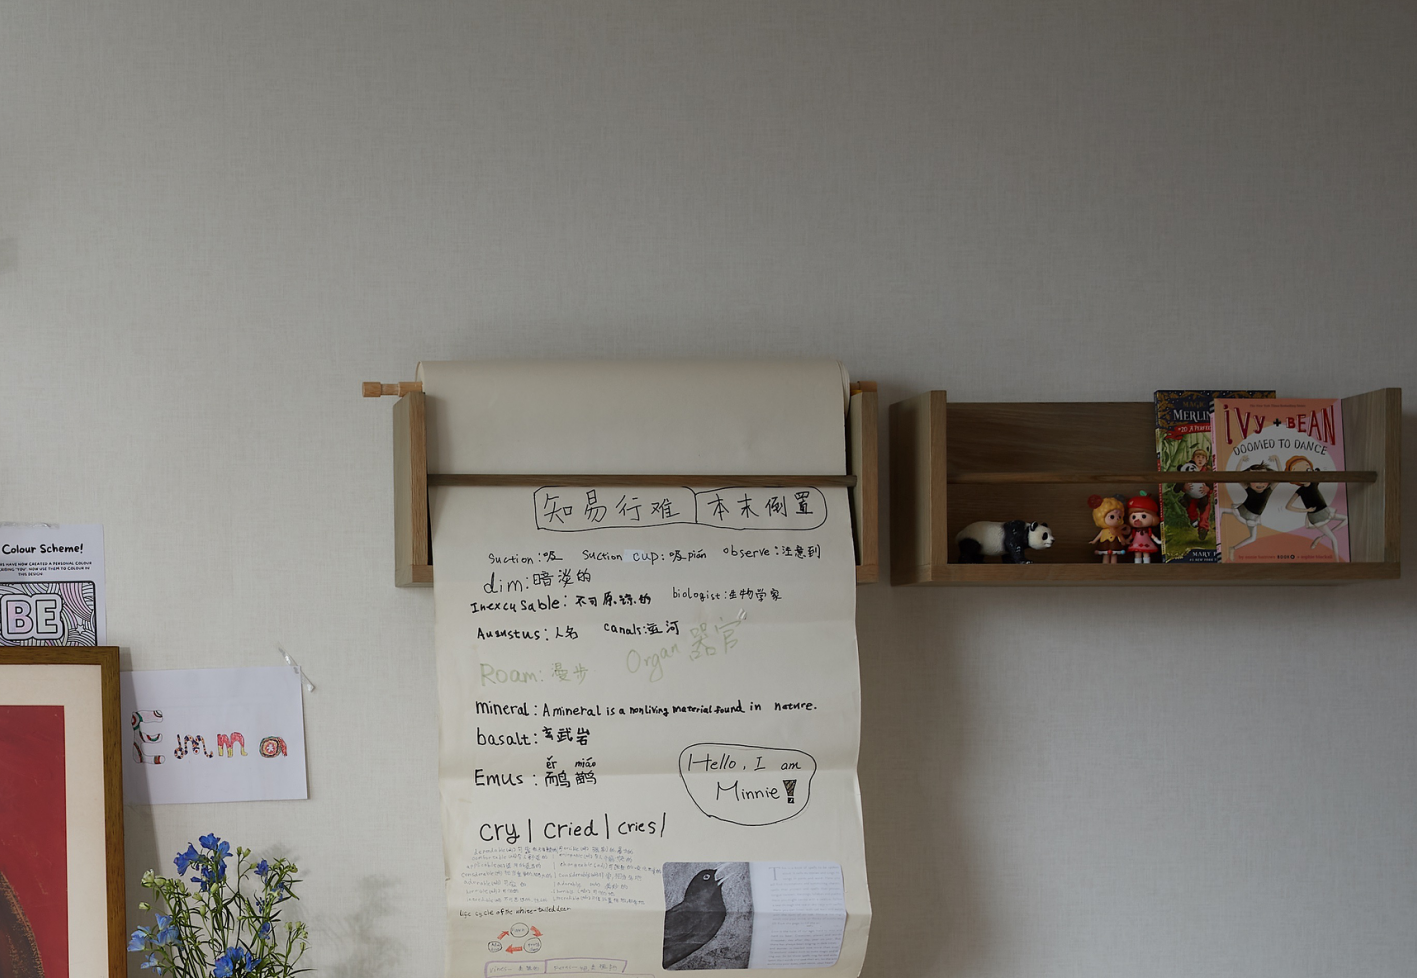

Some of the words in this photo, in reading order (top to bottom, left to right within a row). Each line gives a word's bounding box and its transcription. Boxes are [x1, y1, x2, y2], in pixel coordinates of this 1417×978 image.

[1286, 404, 1336, 446] BEAN
[1234, 438, 1276, 456] DOOMED
[1280, 438, 1291, 449] TO
[1294, 439, 1328, 456] DANCE
[2, 543, 37, 555] Colour
[40, 543, 84, 554] Scheme!
[6, 600, 58, 635] BE
[626, 642, 681, 684] Organ
[606, 706, 615, 716] is
[749, 702, 762, 712] in
[780, 760, 802, 771] am
